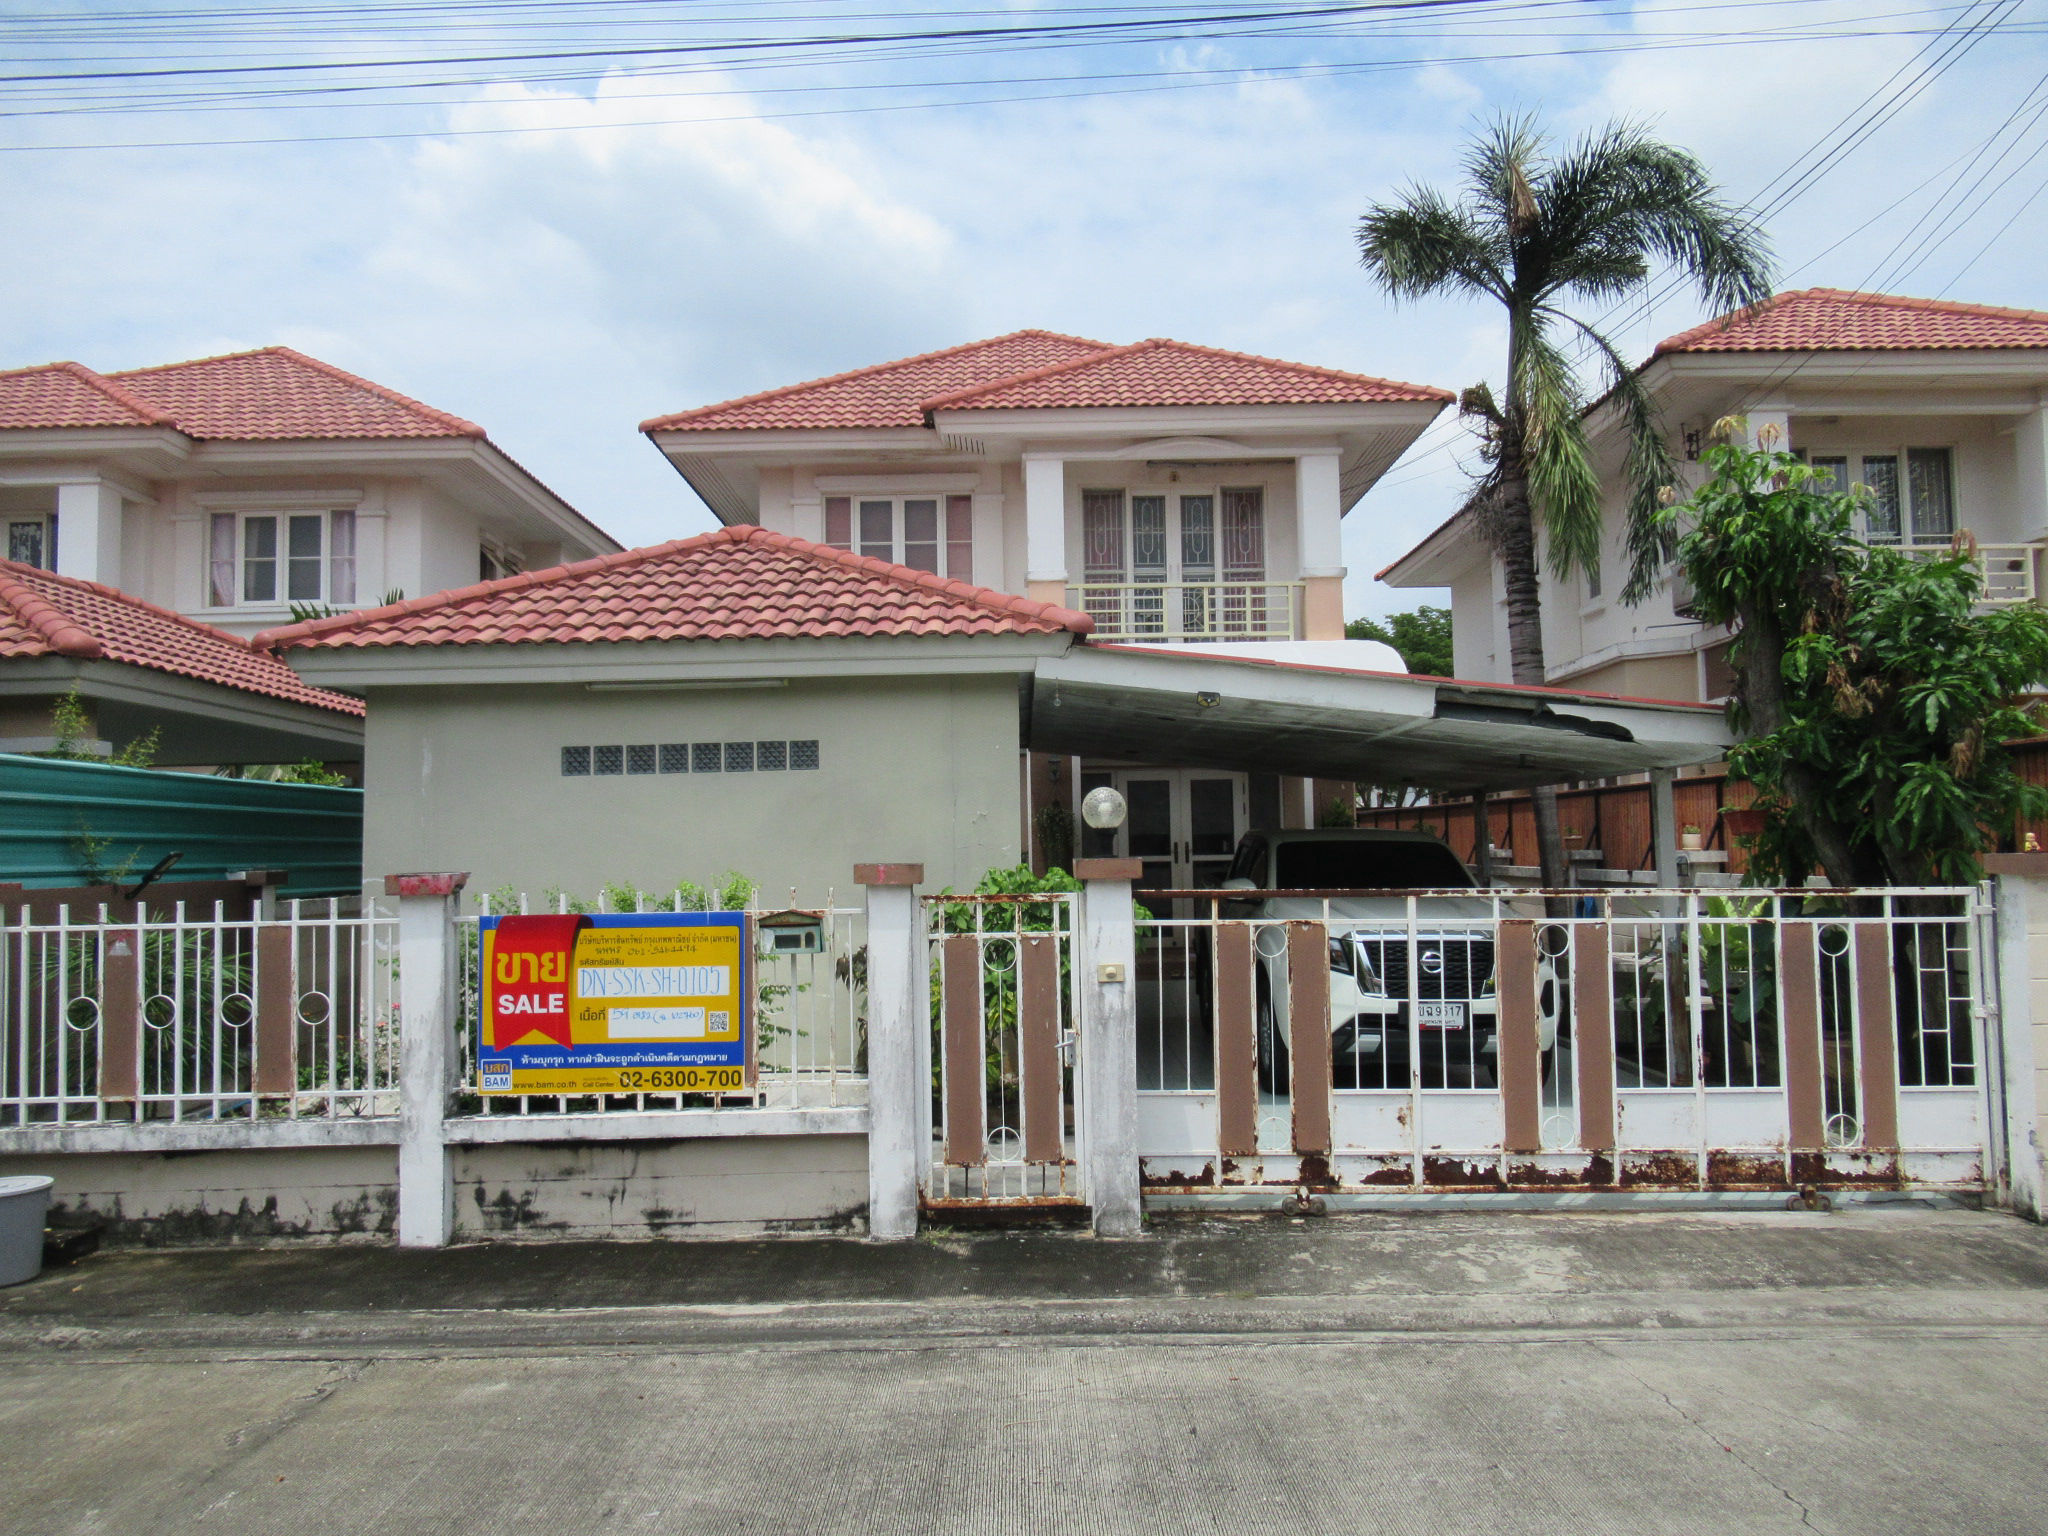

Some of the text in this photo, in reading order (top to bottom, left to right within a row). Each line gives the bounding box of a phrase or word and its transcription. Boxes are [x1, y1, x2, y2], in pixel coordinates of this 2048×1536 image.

[692, 934, 709, 943] จำกัด
[709, 934, 738, 945] (มหาชน)
[497, 951, 566, 984] ขาย
[581, 966, 720, 996] DN-SSK-SH-0105
[498, 993, 564, 1015] SALE
[579, 1006, 606, 1021] เนื้อที่
[521, 1053, 565, 1066] ห้ามบุกรุก
[484, 1063, 509, 1073] บสก
[484, 1077, 508, 1087] BAM
[513, 1081, 577, 1089] www.bam.co.th
[620, 1070, 742, 1088] 02-6300-700
